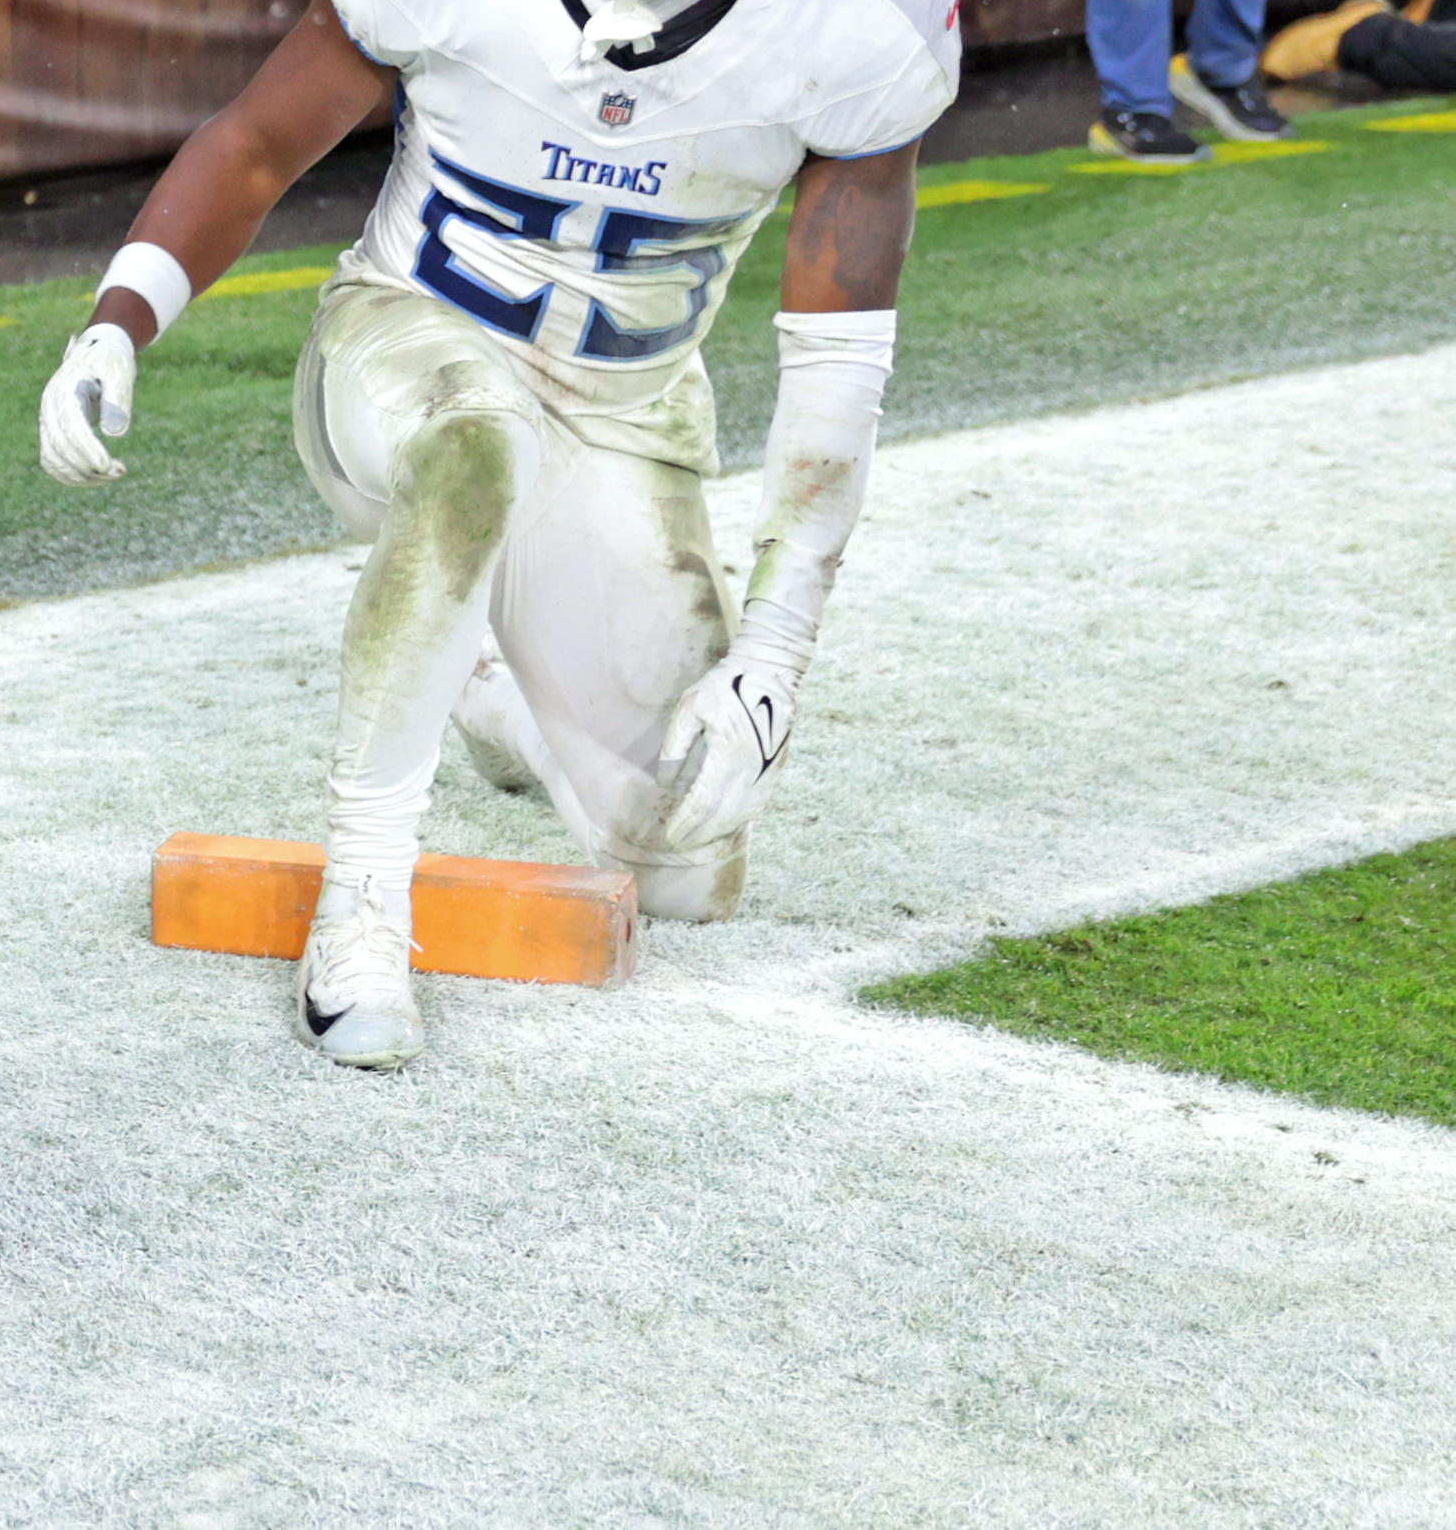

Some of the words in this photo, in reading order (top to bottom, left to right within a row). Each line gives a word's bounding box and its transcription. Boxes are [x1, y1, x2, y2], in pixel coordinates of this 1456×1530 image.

[602, 105, 631, 125] NFL
[541, 140, 668, 197] TITANS
[409, 143, 753, 363] 25
